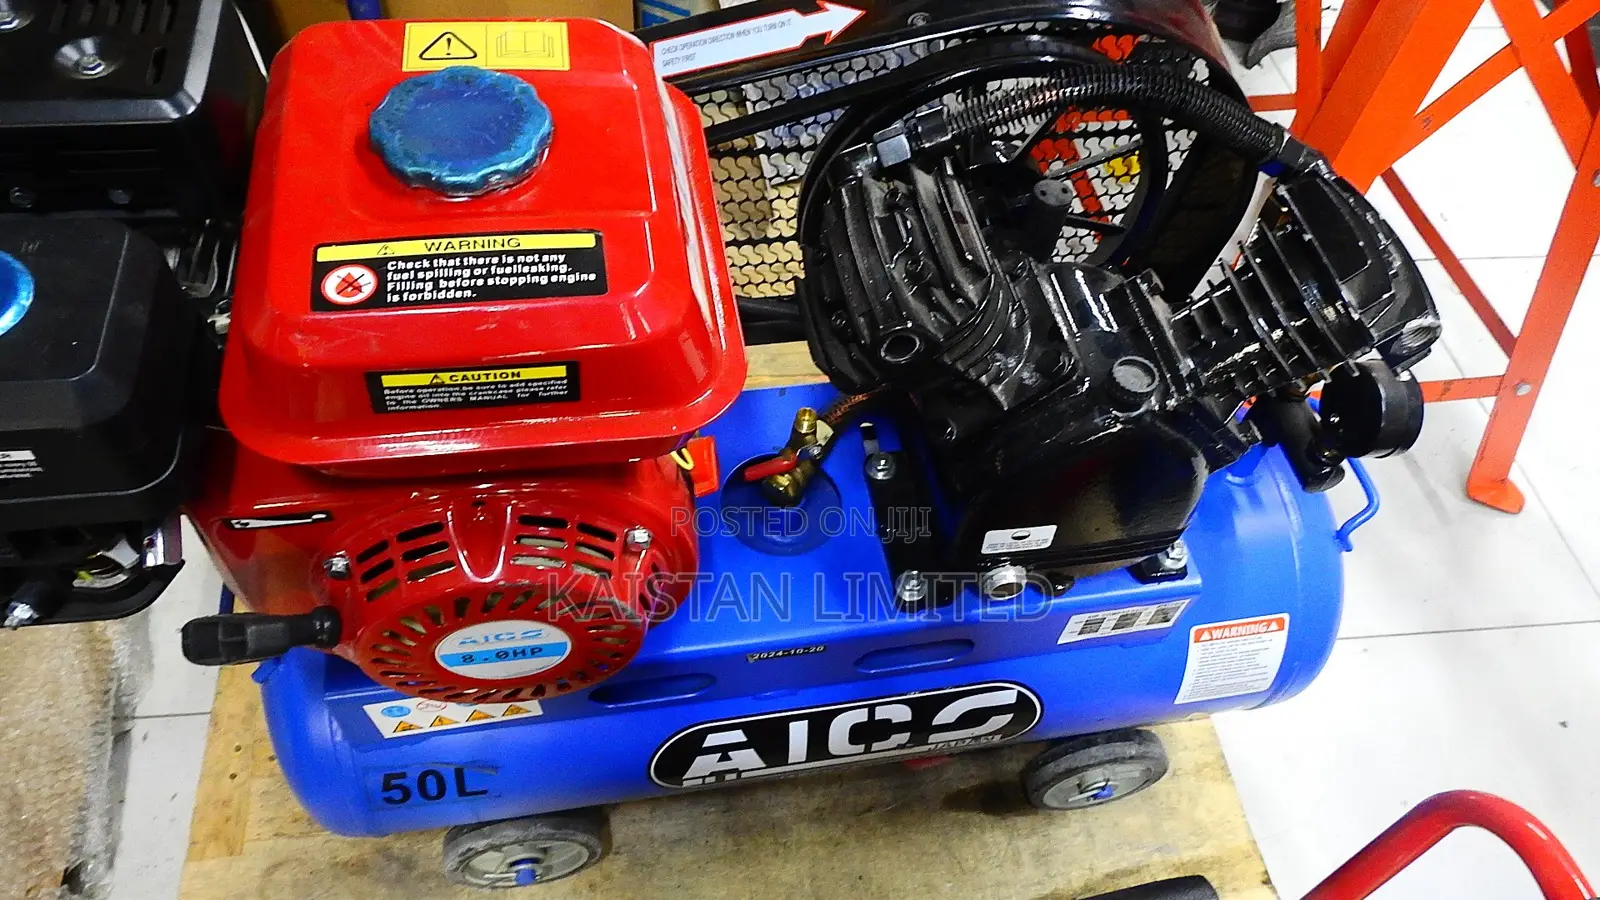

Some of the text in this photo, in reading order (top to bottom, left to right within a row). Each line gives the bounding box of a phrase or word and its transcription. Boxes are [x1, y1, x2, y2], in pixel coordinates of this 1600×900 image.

[680, 39, 707, 51] OPERATION
[708, 32, 735, 45] DIRECTION
[425, 237, 521, 252] WARNING
[387, 253, 566, 271] Check that there is not any
[387, 270, 415, 281] fuel
[417, 267, 471, 281] spilling
[473, 267, 488, 277] or
[387, 271, 597, 292] Filling before stopping engine
[387, 292, 401, 303] is
[449, 371, 521, 382] CAUTION
[528, 379, 568, 387] specified
[1211, 621, 1268, 640] WARNING
[461, 646, 544, 663] 8.0HP
[752, 644, 825, 660] 2024-10-20
[381, 767, 489, 805] 50L
